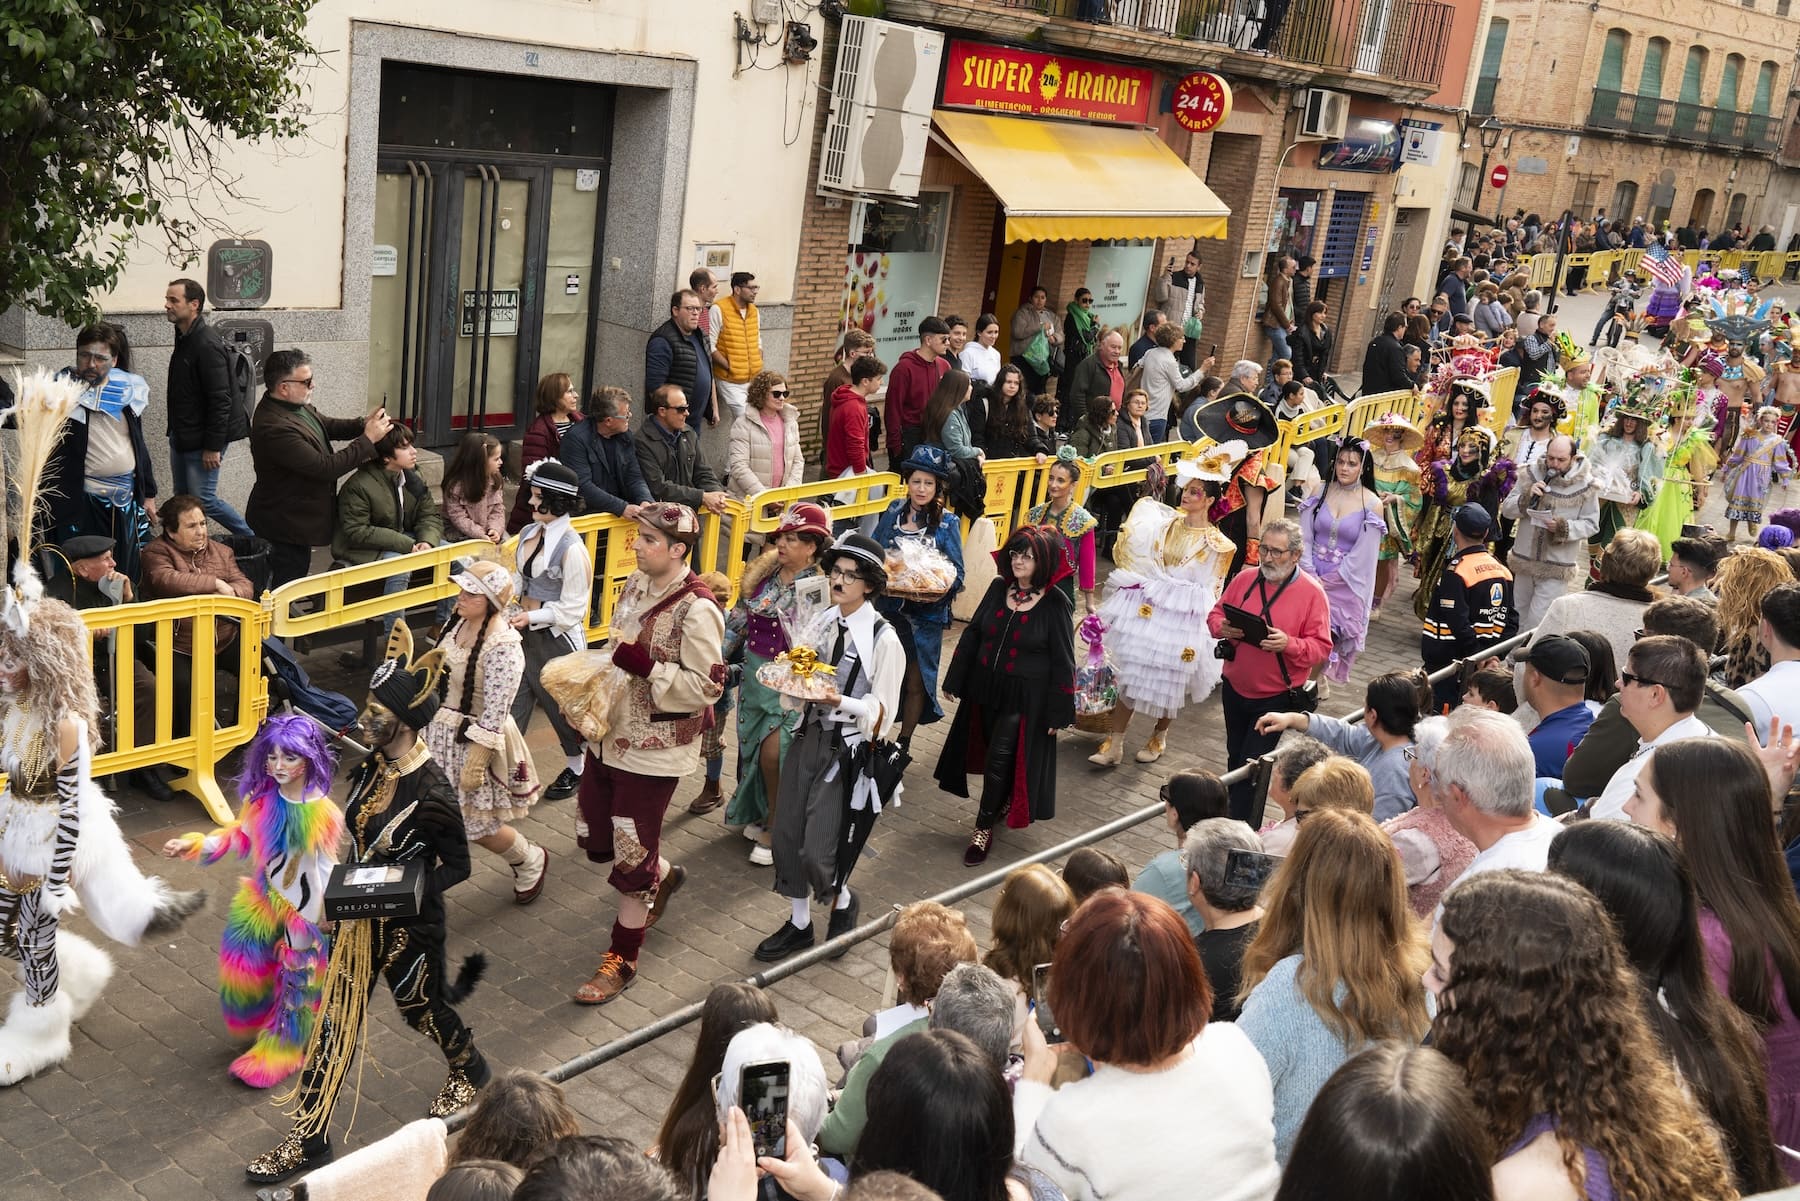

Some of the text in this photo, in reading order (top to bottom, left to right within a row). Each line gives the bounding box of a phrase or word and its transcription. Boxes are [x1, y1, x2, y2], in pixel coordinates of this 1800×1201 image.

[962, 56, 1034, 93] SUPER
[1065, 70, 1141, 106] ARARAT
[1179, 76, 1221, 100] TIENDA
[1177, 94, 1218, 113] 24 h.
[1176, 110, 1213, 129] ARARAT
[464, 294, 476, 307] SE
